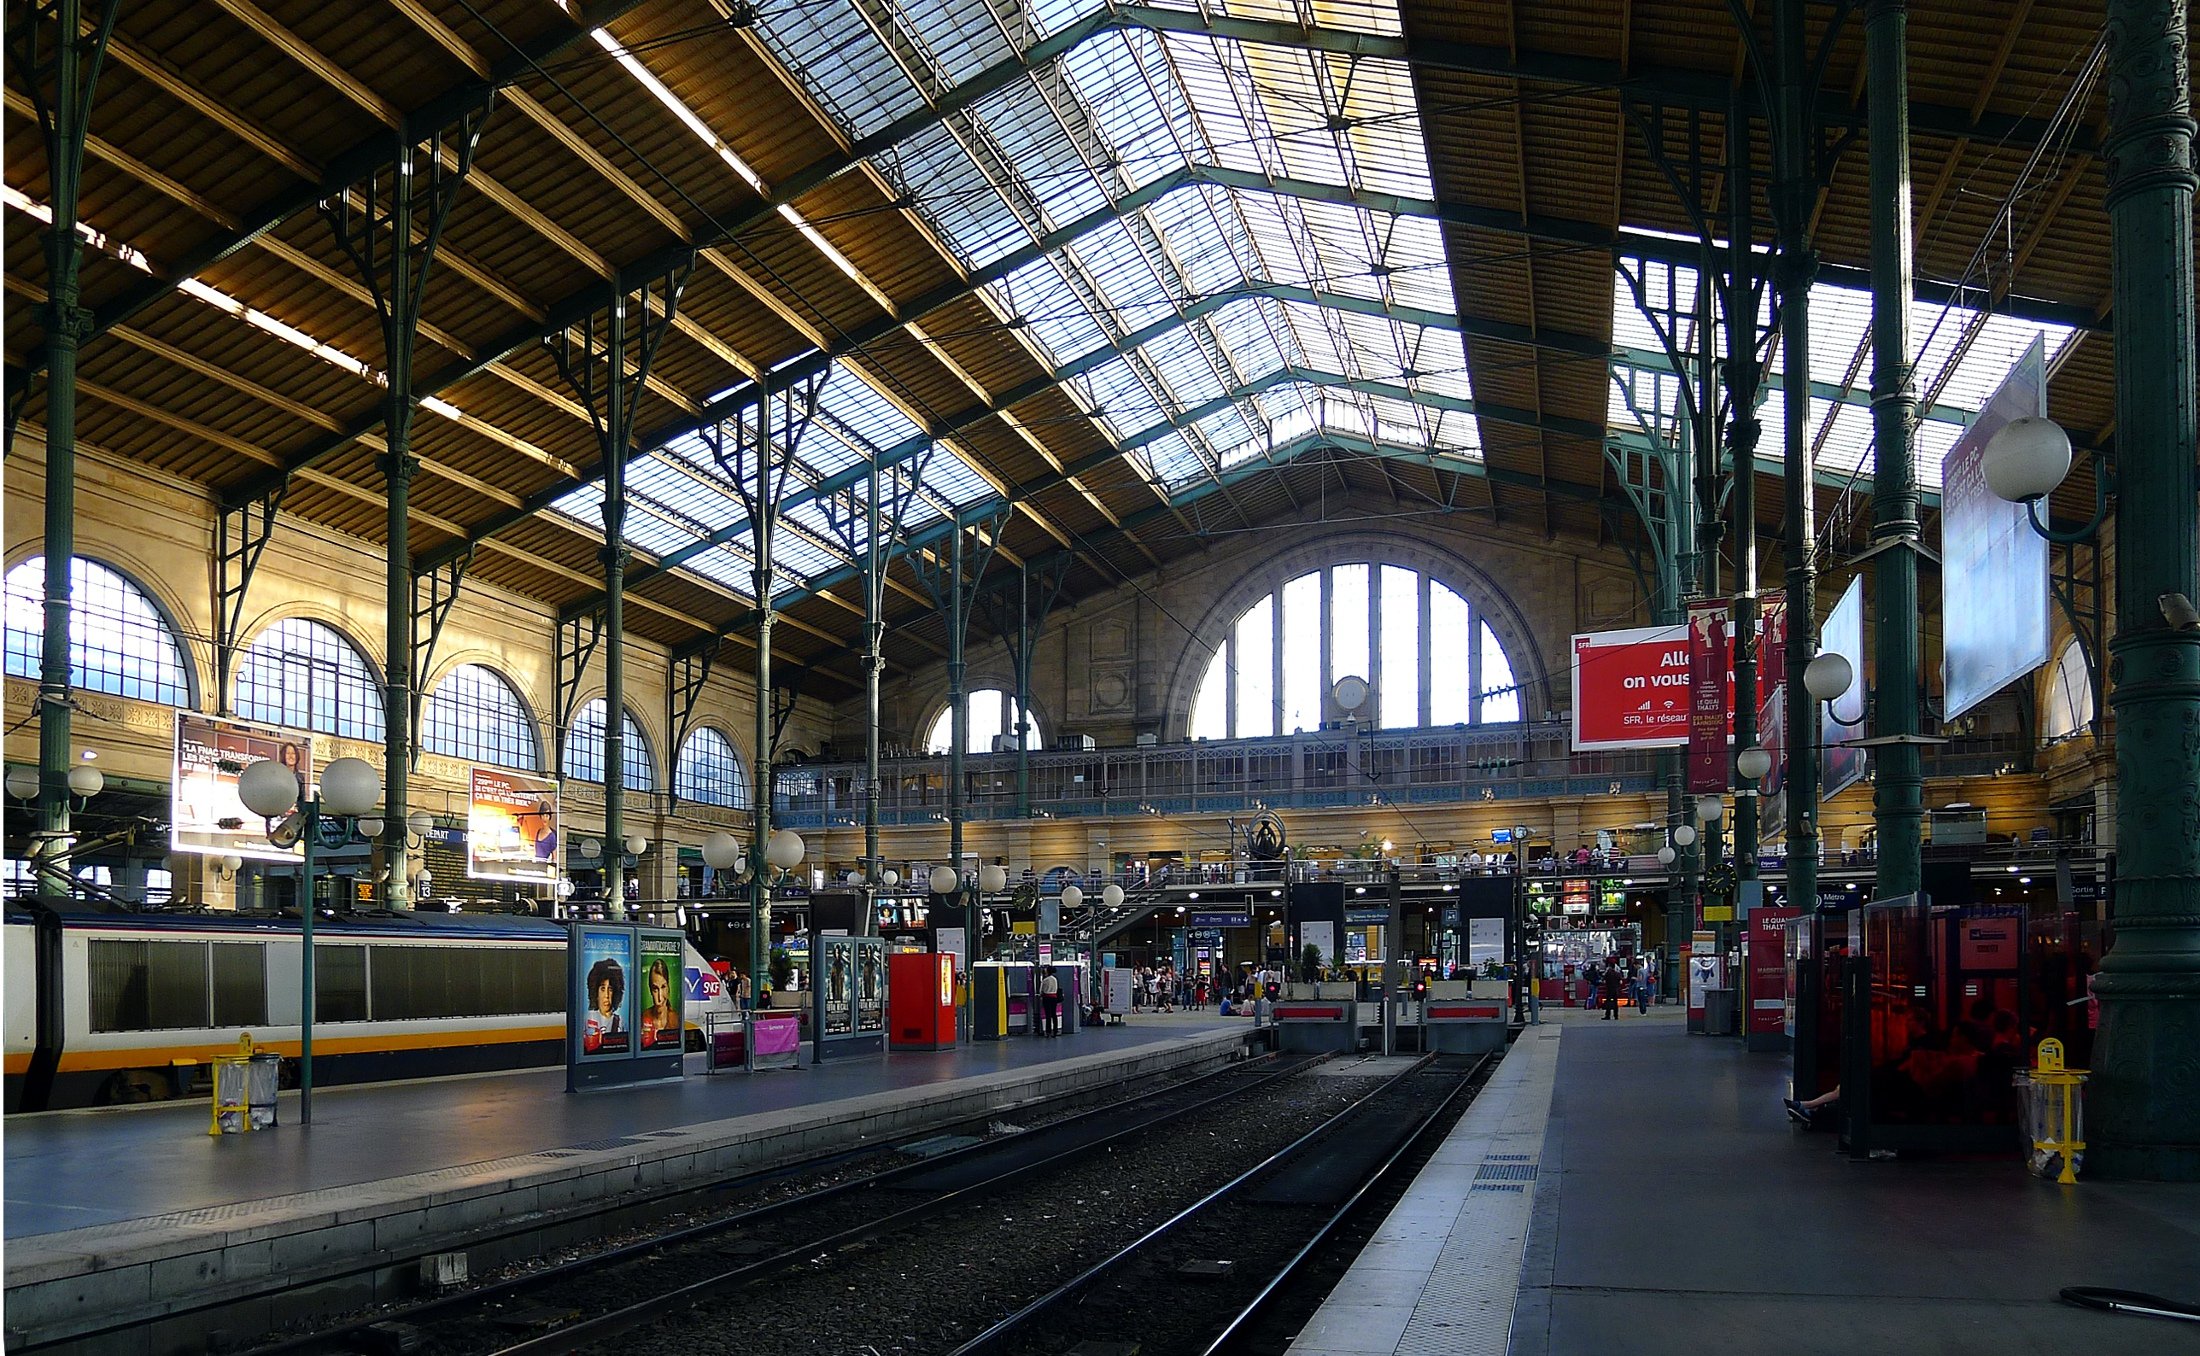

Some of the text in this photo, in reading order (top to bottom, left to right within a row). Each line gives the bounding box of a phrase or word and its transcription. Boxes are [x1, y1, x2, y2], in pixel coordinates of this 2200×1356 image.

[1578, 642, 1590, 650] SFR
[1623, 673, 1690, 689] on vous
[1623, 712, 1687, 726] SFR, le réseau
[197, 746, 219, 757] FNAC
[219, 750, 271, 762] TRANSFOR
[198, 754, 211, 764] PC
[421, 886, 431, 898] 13
[1823, 893, 1846, 901] Métro
[703, 980, 720, 994] SNCF
